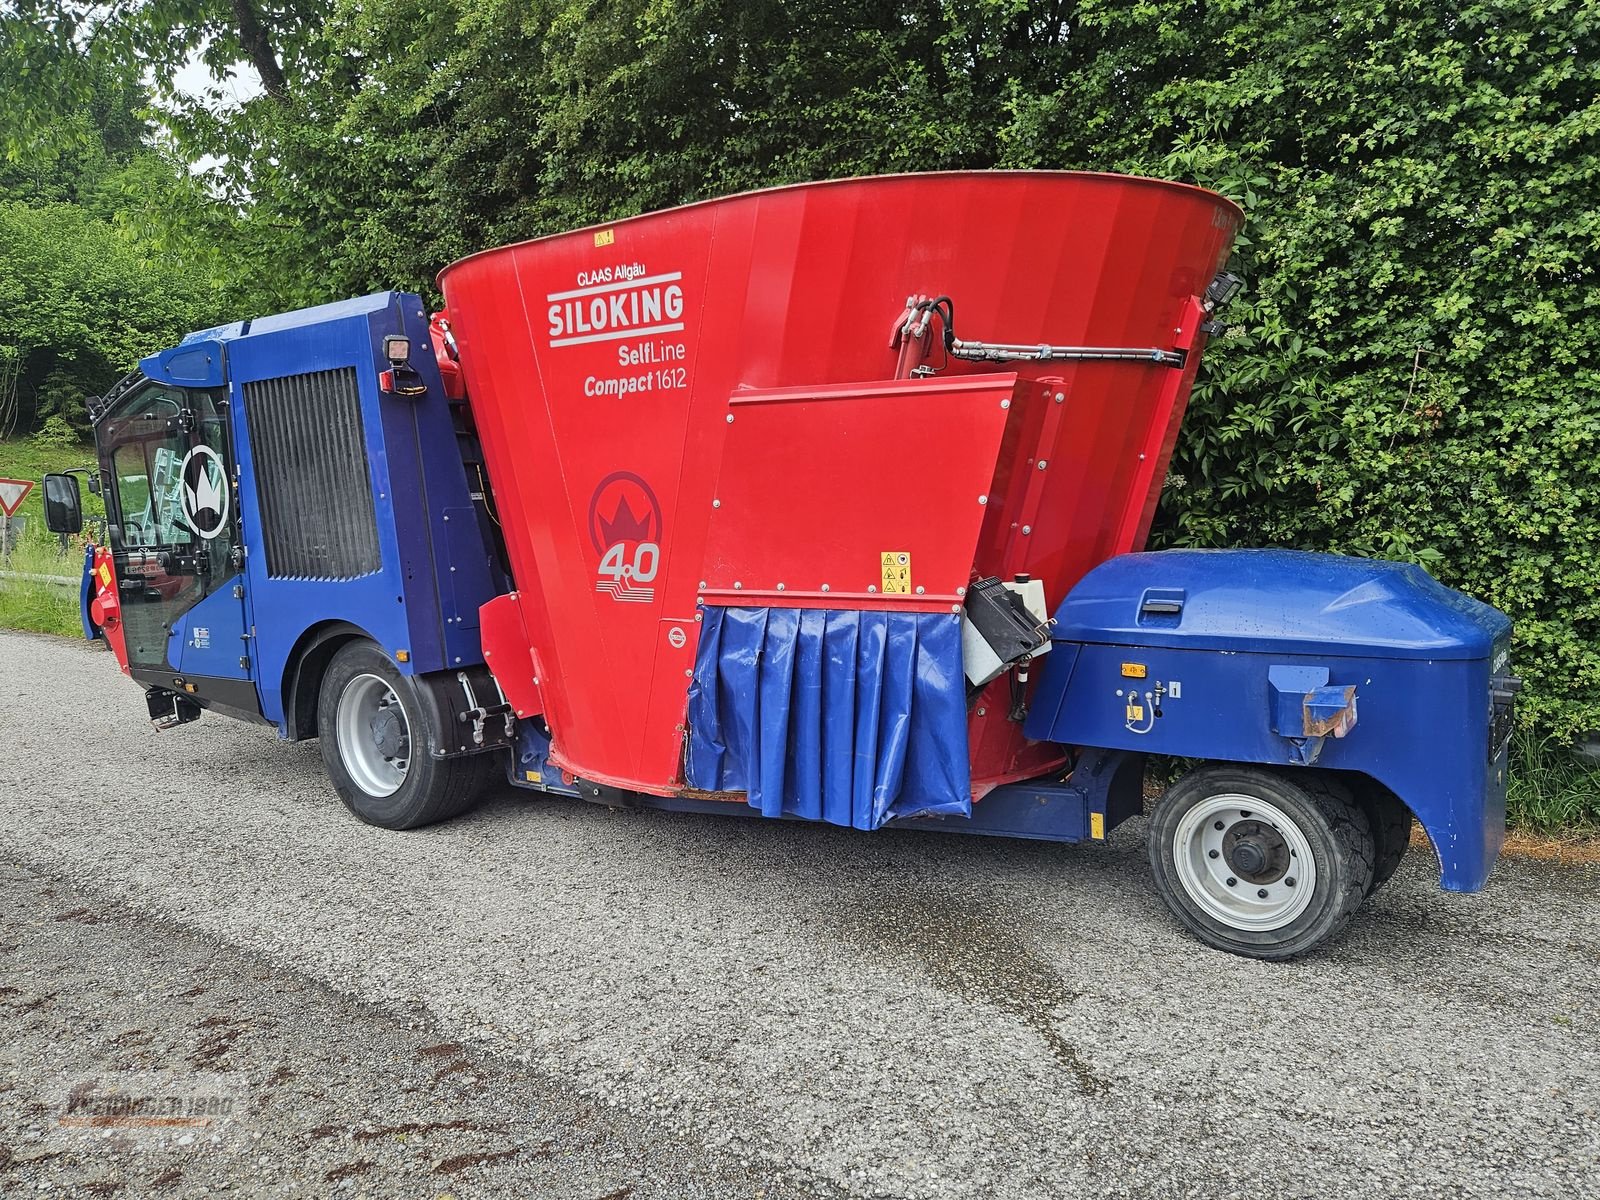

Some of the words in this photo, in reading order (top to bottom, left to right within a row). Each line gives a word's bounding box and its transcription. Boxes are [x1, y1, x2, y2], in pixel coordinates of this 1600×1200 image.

[577, 267, 613, 287] CLAAS
[614, 262, 646, 281] Allgäu
[547, 285, 684, 337] SILOKING
[618, 340, 686, 367] SelfLine
[584, 371, 653, 400] Compact
[655, 367, 687, 390] 1612
